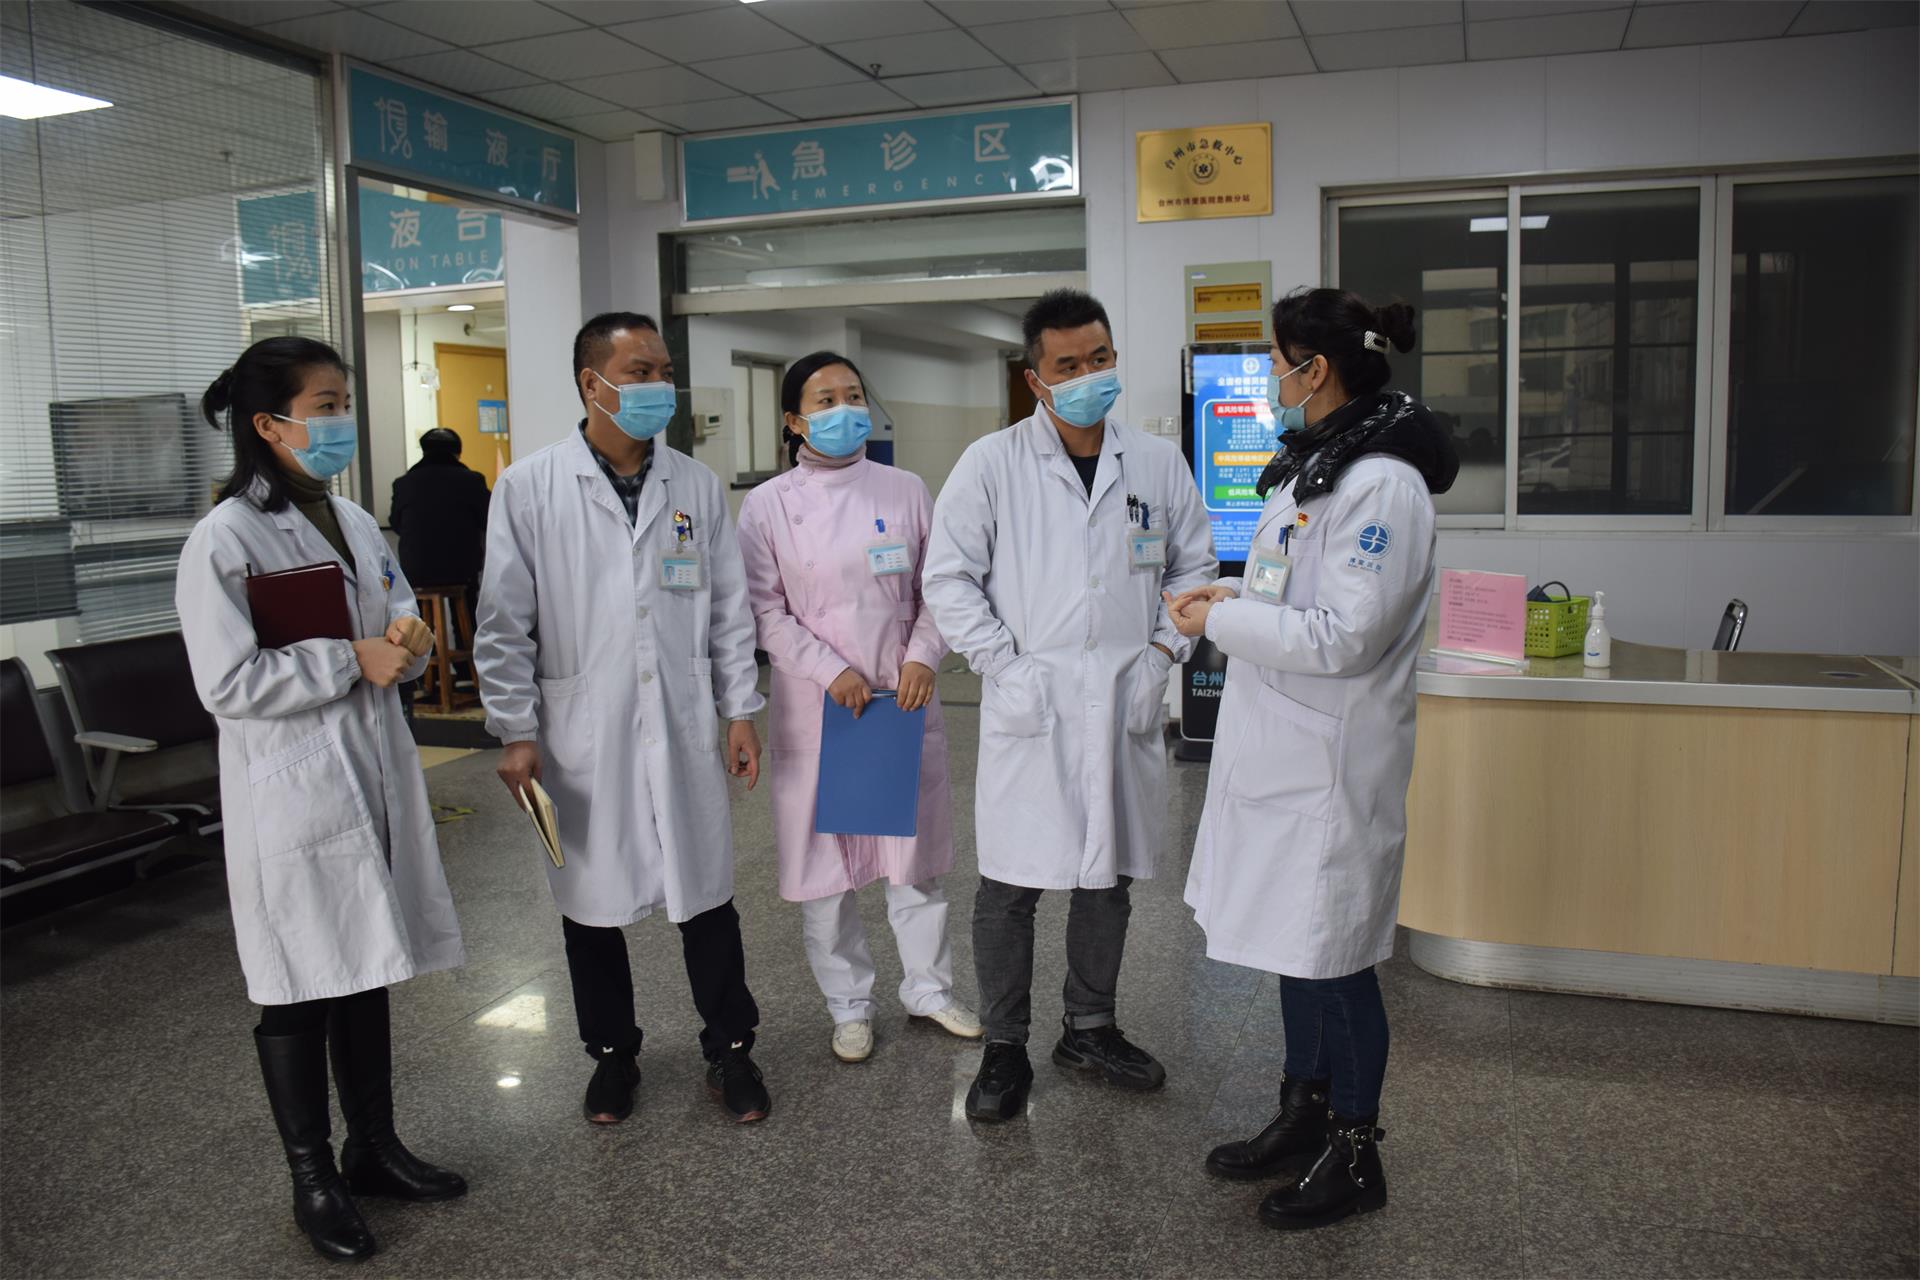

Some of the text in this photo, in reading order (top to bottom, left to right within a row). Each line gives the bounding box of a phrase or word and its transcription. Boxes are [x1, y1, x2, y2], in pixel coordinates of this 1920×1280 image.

[791, 122, 1010, 180] 急诊区
[1164, 138, 1243, 170] 台州市急救中心
[791, 171, 1011, 201] EMERGENCY
[431, 249, 489, 269] TABLE
[1192, 671, 1224, 686] 台州
